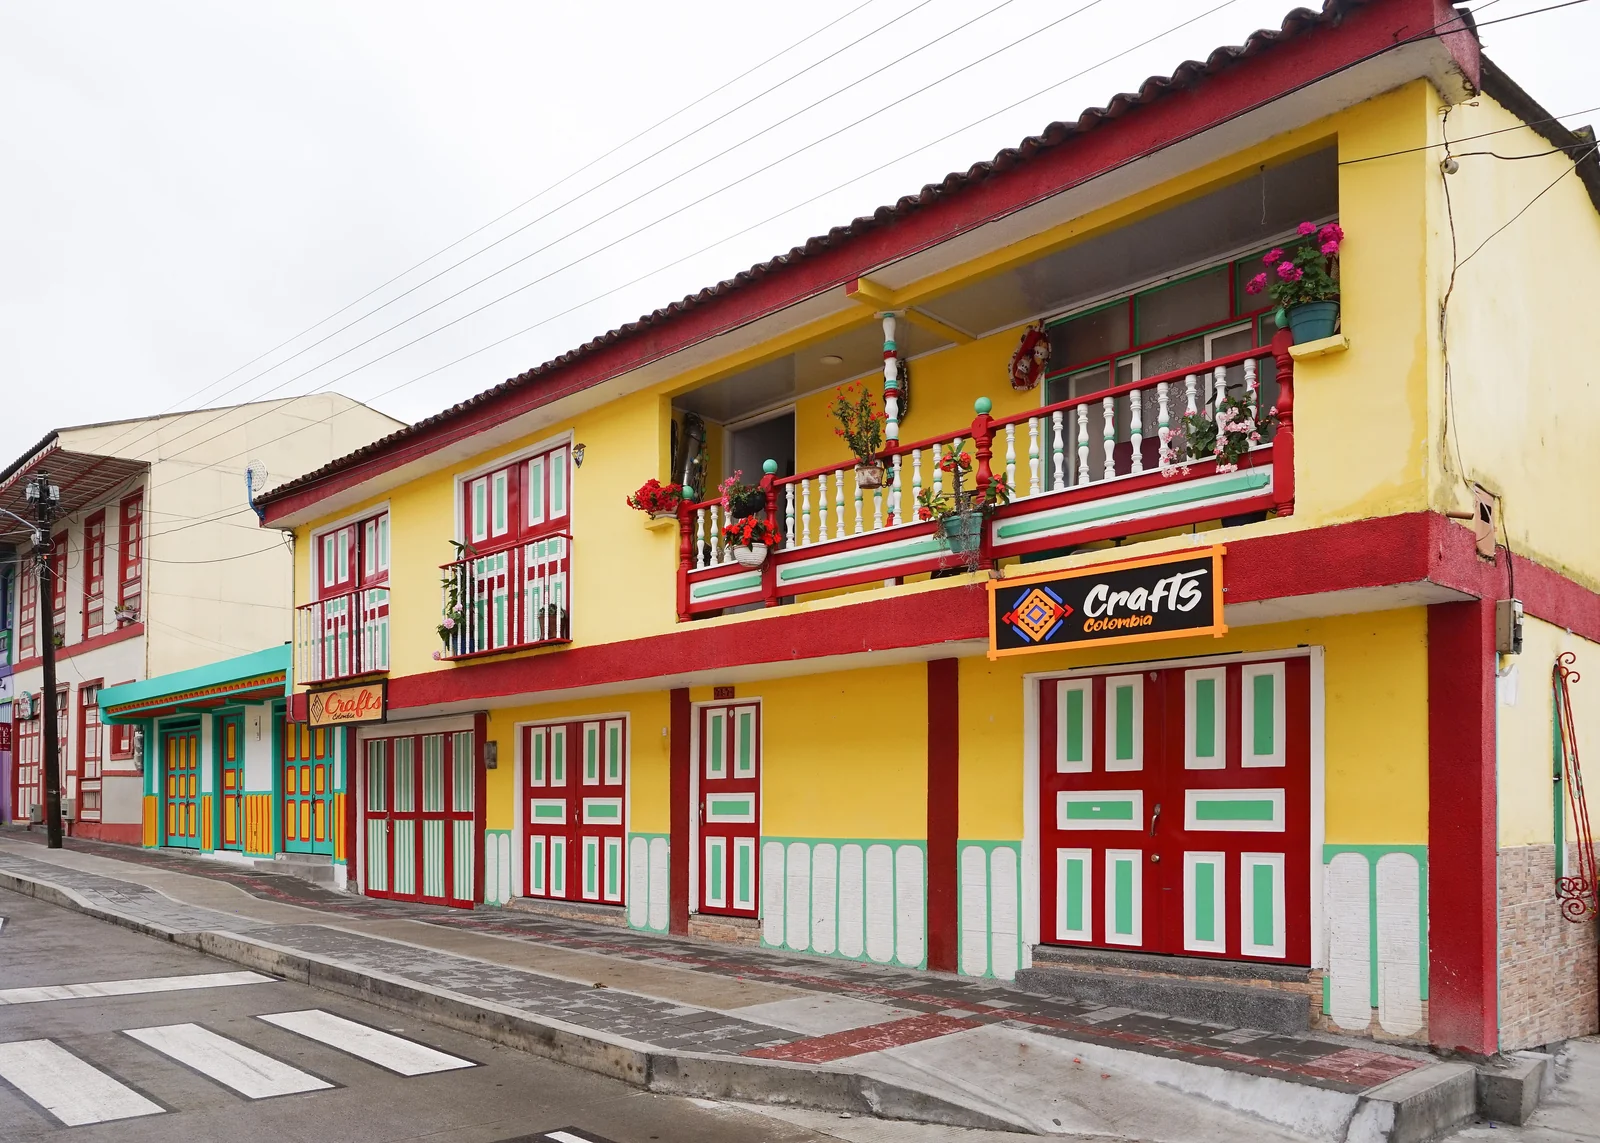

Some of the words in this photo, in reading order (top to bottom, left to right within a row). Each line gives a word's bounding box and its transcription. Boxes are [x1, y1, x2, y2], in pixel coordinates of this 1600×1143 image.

[1083, 568, 1208, 618] Crafts
[1083, 614, 1153, 633] Colombia
[324, 689, 382, 718] Crafts
